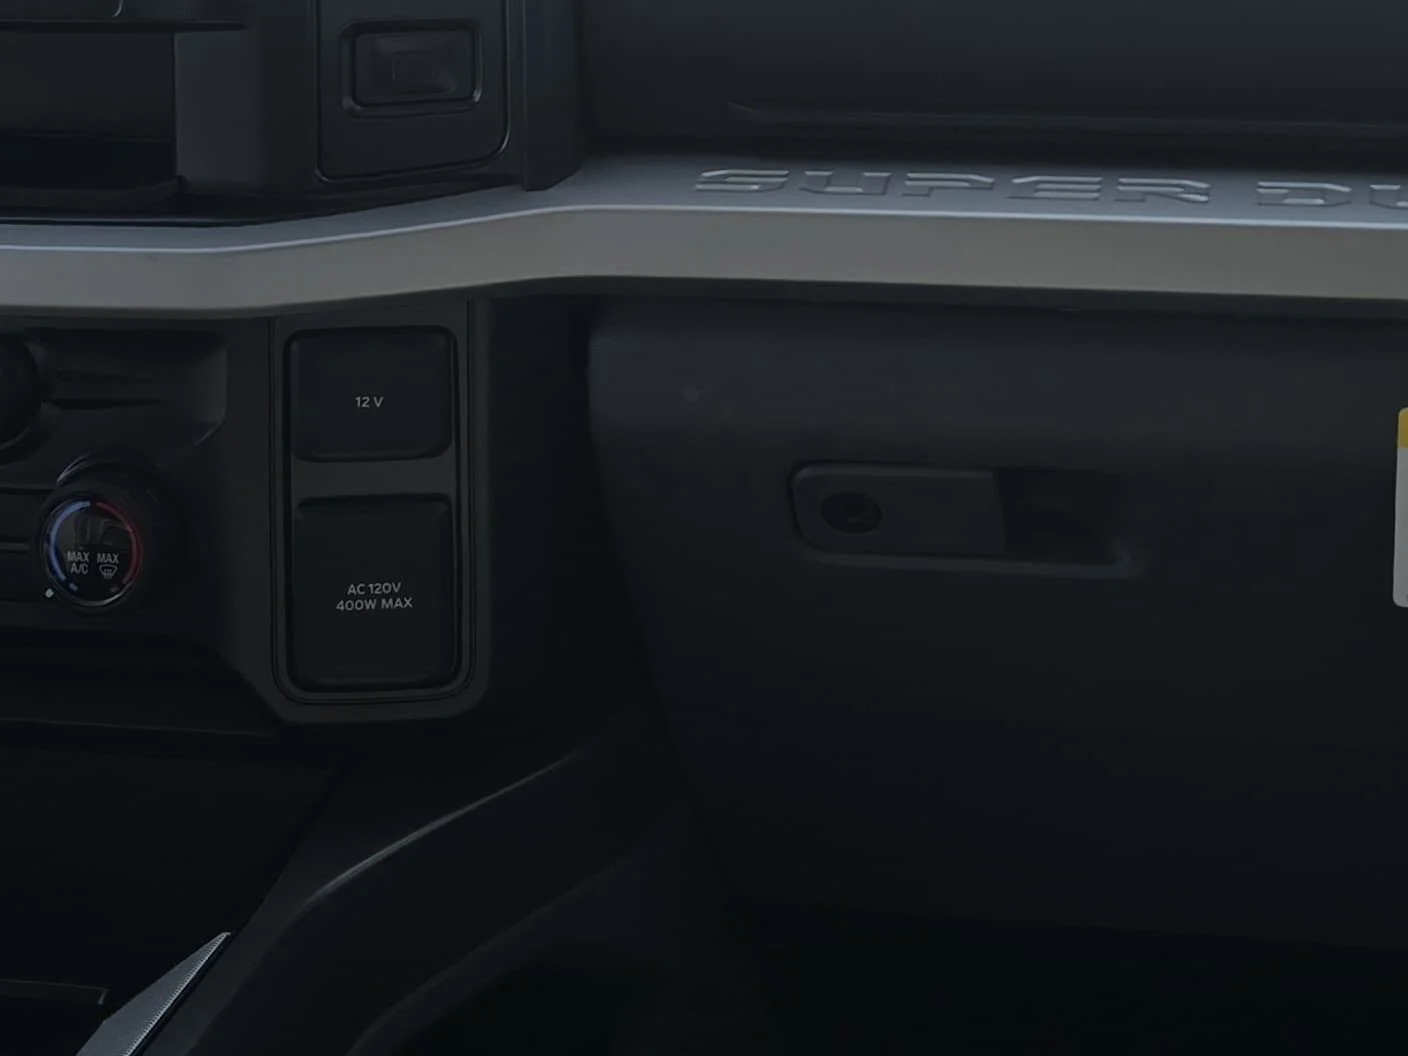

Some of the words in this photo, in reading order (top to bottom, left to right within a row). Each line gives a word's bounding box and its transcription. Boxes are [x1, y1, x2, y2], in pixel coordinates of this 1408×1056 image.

[694, 168, 1210, 204] SUPER
[355, 396, 370, 408] 12
[374, 396, 384, 408] V
[67, 551, 90, 563] MAX
[96, 553, 120, 564] MAX
[70, 563, 89, 575] A/C
[347, 583, 366, 595] AC
[368, 582, 402, 594] 120V
[336, 599, 377, 611] 400W
[381, 597, 413, 609] MAX
